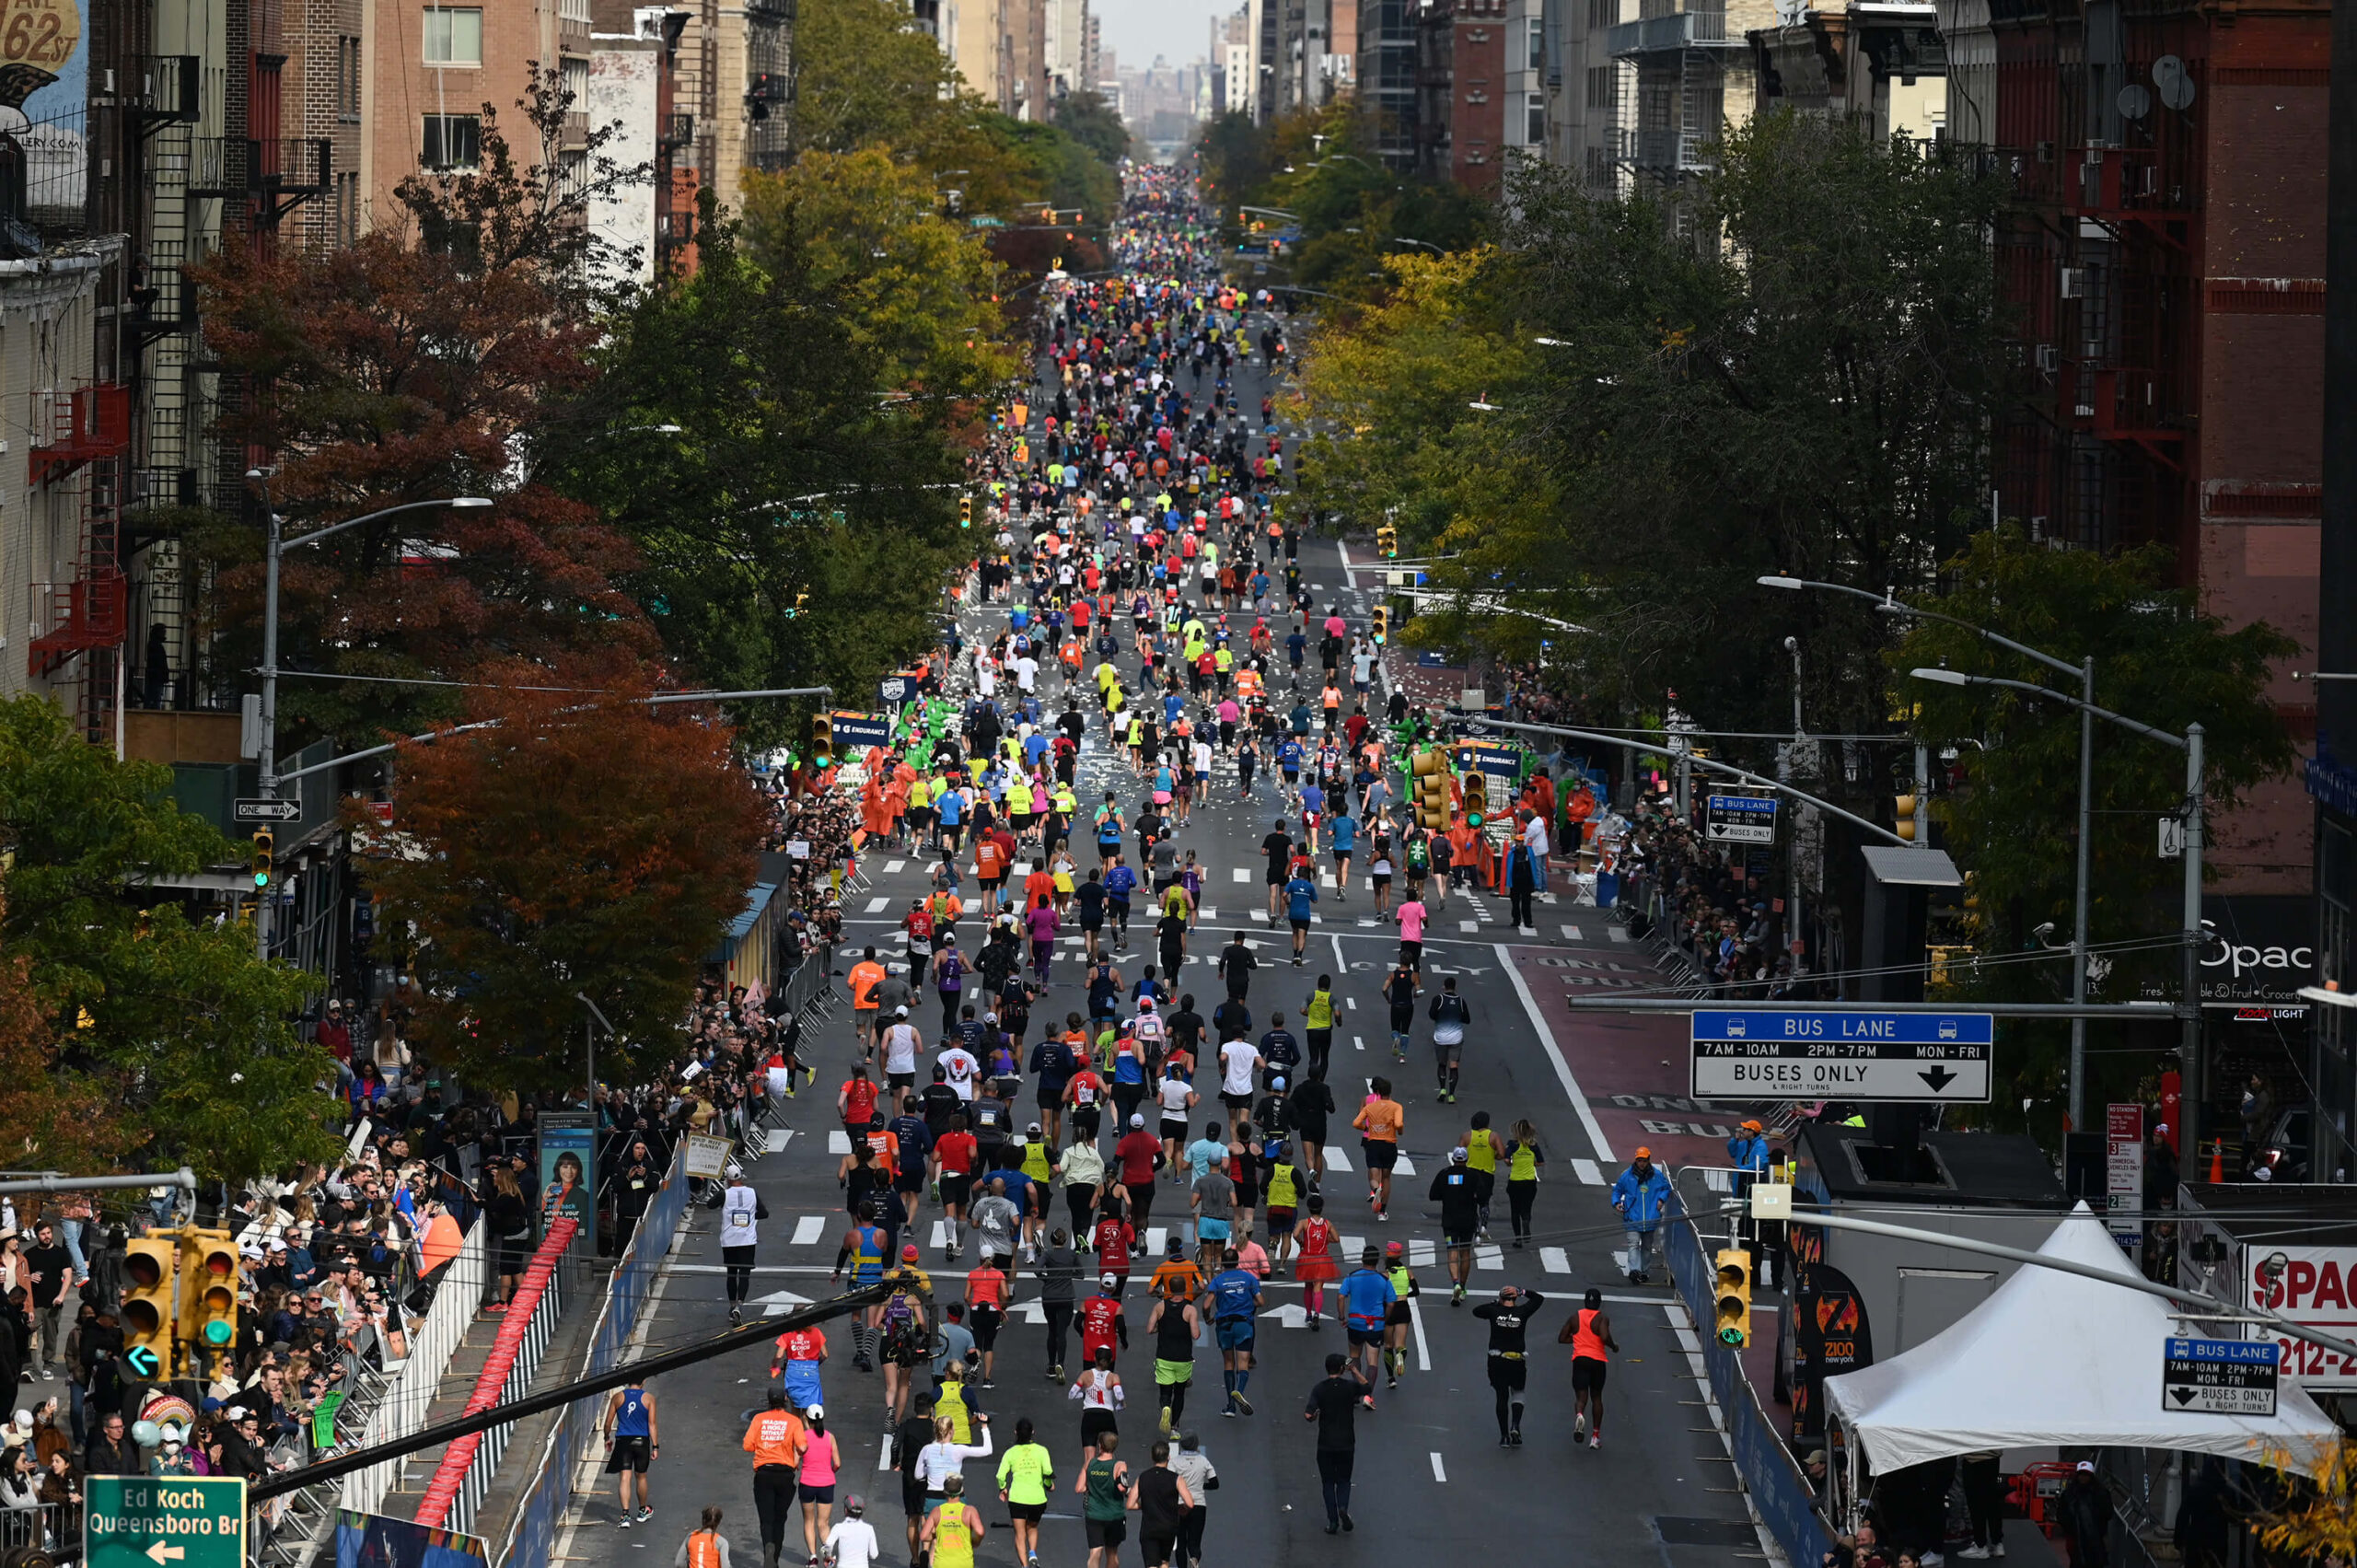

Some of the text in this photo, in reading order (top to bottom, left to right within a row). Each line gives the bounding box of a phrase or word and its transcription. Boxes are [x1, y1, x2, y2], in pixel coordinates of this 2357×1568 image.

[20, 136, 80, 149] LERY.COM
[852, 726, 886, 736] ENDURANCE
[1482, 756, 1516, 765] ENDURANCE
[240, 806, 292, 815] ONE WAY
[1727, 799, 1771, 810] BUS LANE
[1729, 828, 1770, 838] BUSES ONLY
[2232, 984, 2252, 999] Fruit
[2273, 1009, 2304, 1019] LIGHT
[1784, 1018, 1896, 1038] BUS LANE
[1916, 1046, 1945, 1058] MON
[1958, 1047, 1980, 1059] FRI
[1734, 1064, 1868, 1082] BUSES ONLY
[2110, 1143, 2118, 1155] 3
[2110, 1196, 2118, 1208] 2
[1825, 1341, 1854, 1357] Z100
[2196, 1344, 2270, 1360] BUS LANE
[1840, 1355, 1855, 1365] york
[2197, 1375, 2220, 1384] MON
[2228, 1376, 2245, 1386] FRI
[2201, 1388, 2271, 1402] BUSES ONLY
[2215, 1401, 2238, 1411] RIGHT
[2242, 1403, 2268, 1412] TURNS
[124, 1488, 204, 1509] Ed Koch
[89, 1513, 239, 1535] Queensboro Br
